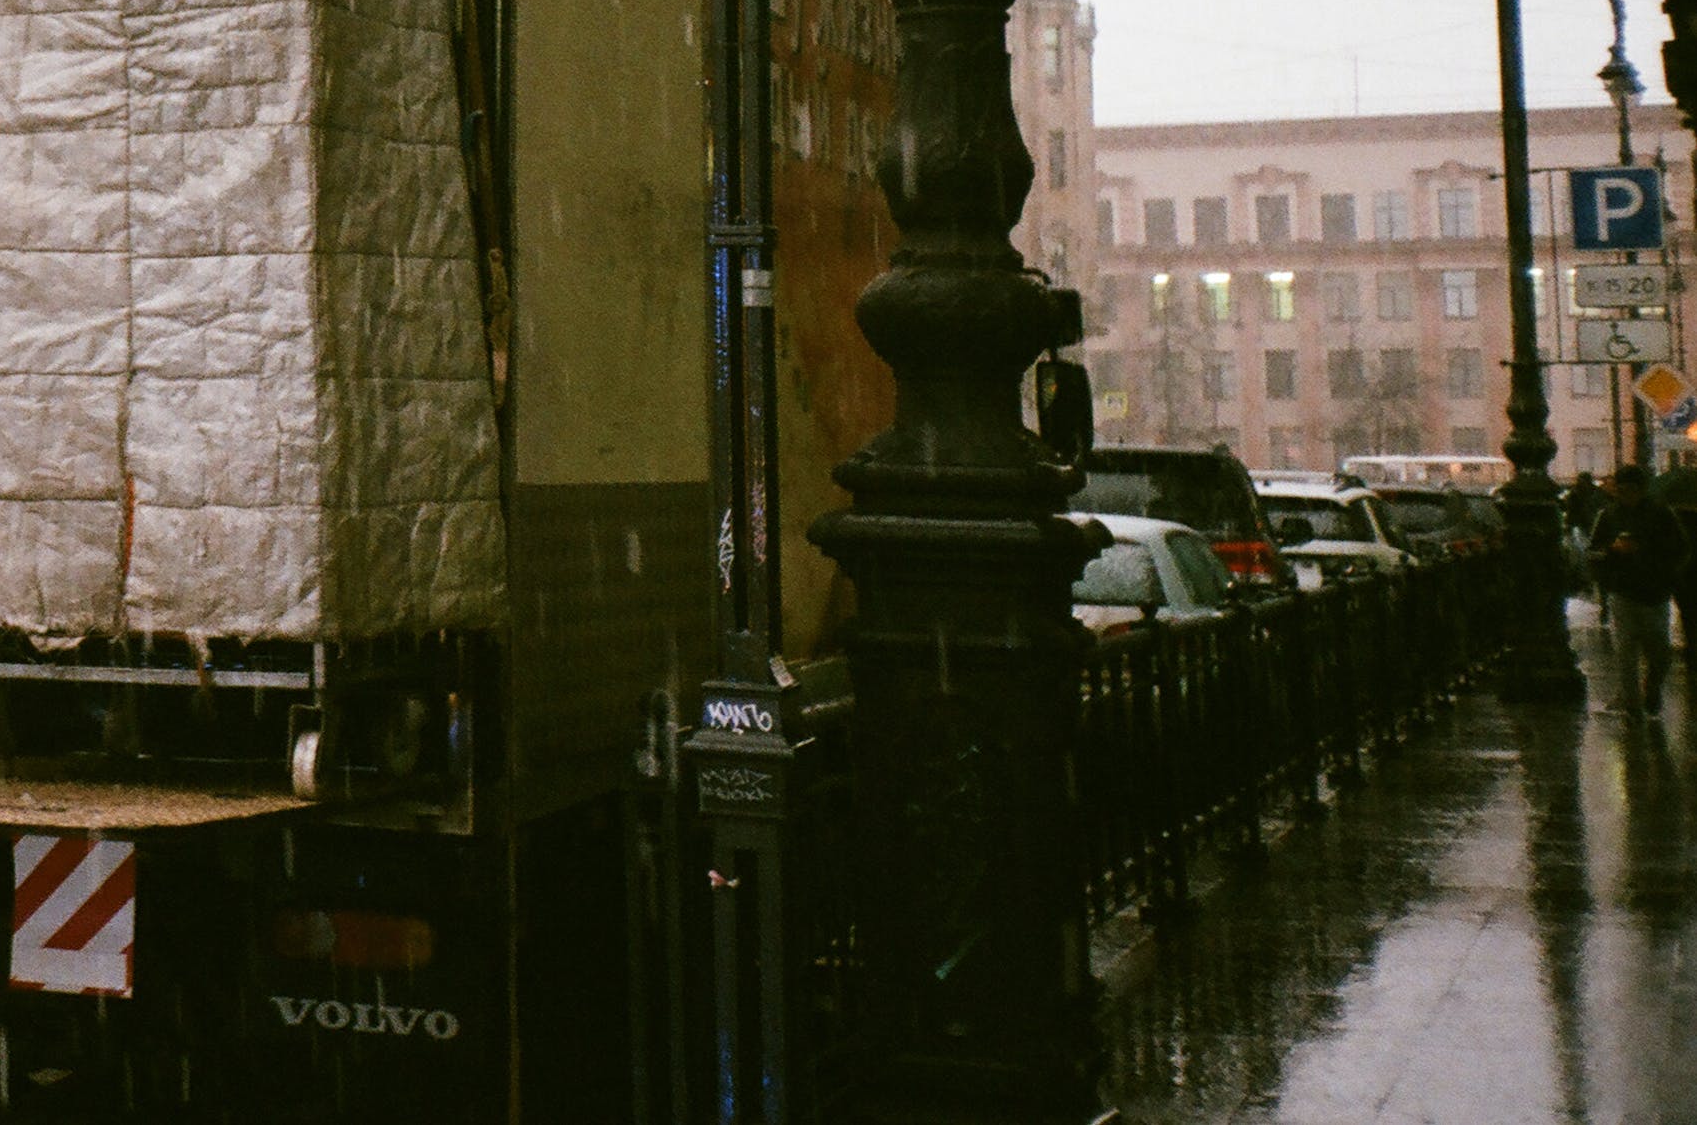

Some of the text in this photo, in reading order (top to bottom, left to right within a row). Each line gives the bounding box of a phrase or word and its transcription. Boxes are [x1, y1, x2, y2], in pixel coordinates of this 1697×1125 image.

[1594, 177, 1644, 242] P
[1605, 278, 1622, 293] 15
[1628, 276, 1656, 294] 20
[270, 996, 460, 1040] VOLVO
